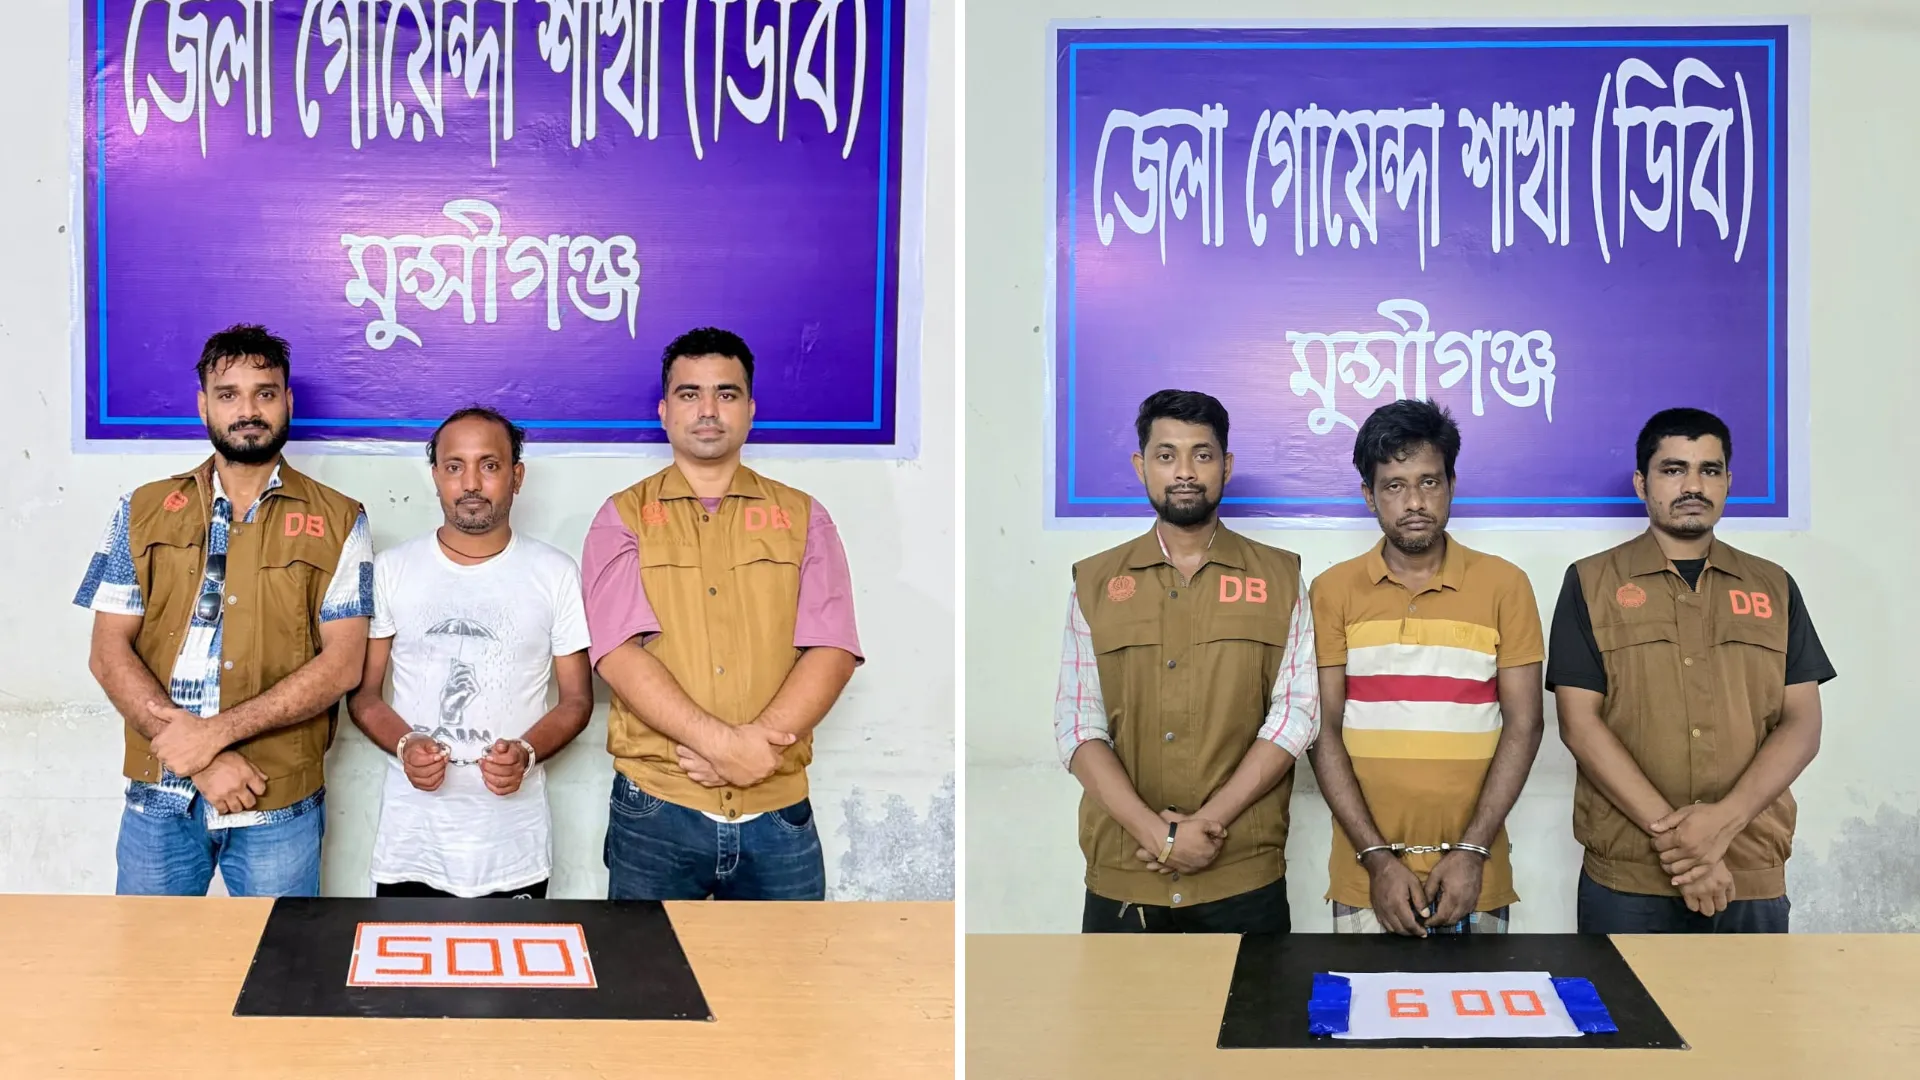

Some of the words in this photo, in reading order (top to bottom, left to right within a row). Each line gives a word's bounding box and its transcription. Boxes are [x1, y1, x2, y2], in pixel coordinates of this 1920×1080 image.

[124, 0, 273, 157] জেলা
[536, 0, 664, 149] শাখা
[1093, 103, 1229, 265] জেলা
[1245, 103, 1445, 270] গোয়েন্দা
[1458, 101, 1575, 253] শাখা
[1592, 57, 1754, 263] (ডিবি)
[284, 512, 325, 537] DB
[744, 505, 792, 531] DB
[1219, 575, 1268, 603] DB
[1728, 589, 1773, 619] DB
[375, 936, 576, 977] 500
